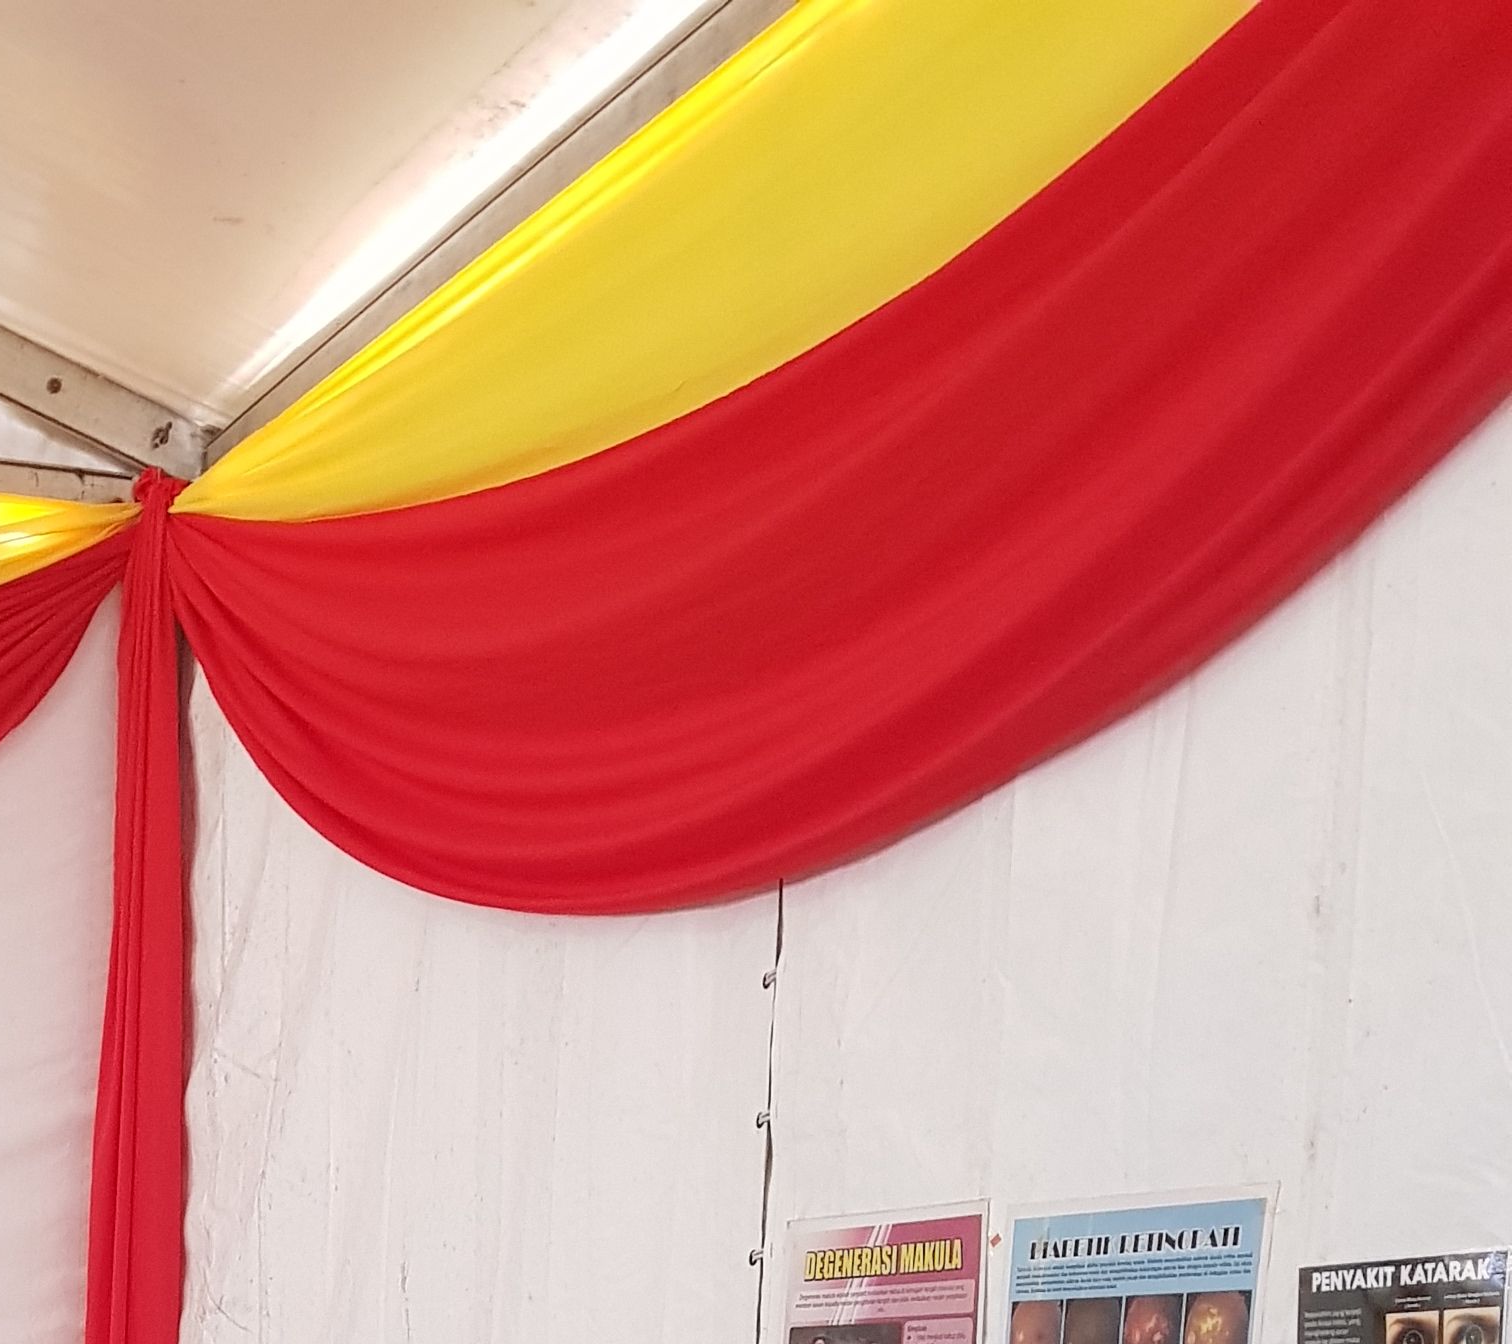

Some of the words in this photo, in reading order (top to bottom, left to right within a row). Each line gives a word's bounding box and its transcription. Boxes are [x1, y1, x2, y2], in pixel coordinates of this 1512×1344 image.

[1119, 1225, 1242, 1254] RETINOPATI
[803, 1245, 897, 1282] DEGENERASI
[899, 1238, 963, 1275] MAKULA
[1311, 1266, 1395, 1293] PENYAKIT
[1399, 1258, 1491, 1286] KATARAK
